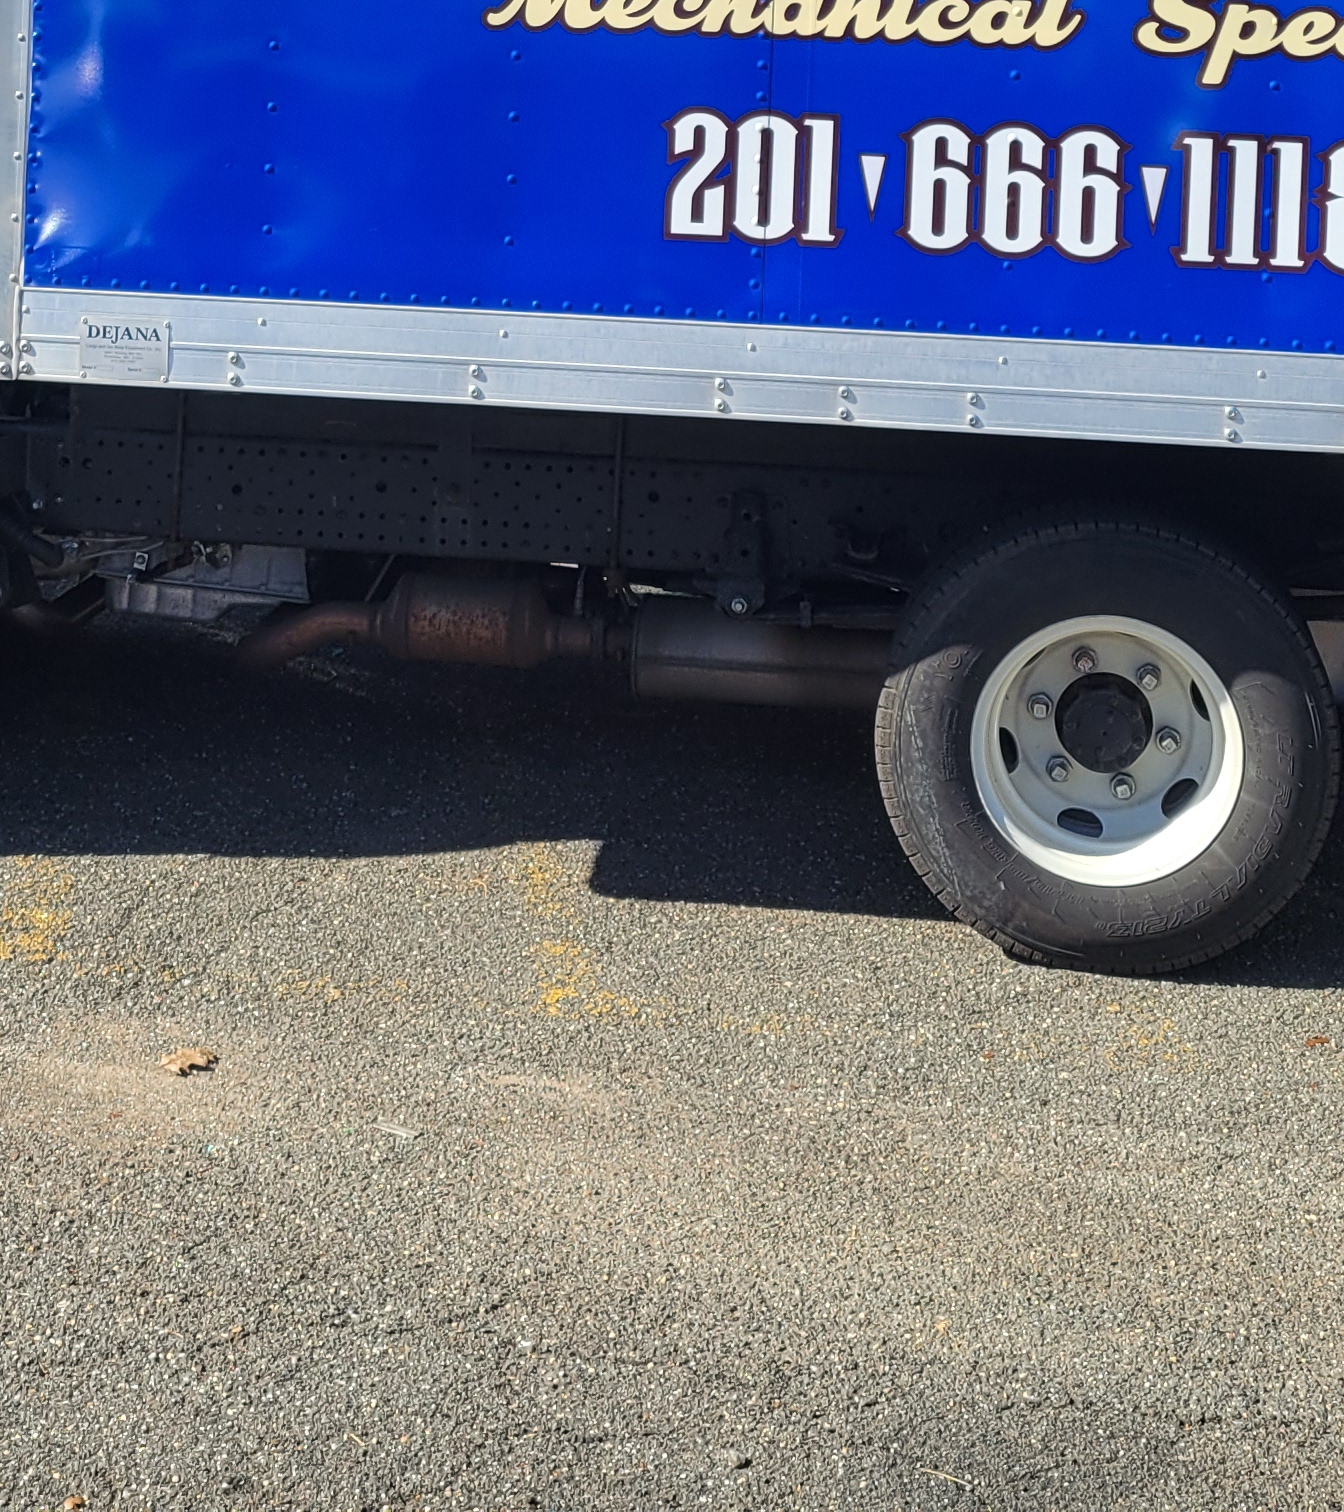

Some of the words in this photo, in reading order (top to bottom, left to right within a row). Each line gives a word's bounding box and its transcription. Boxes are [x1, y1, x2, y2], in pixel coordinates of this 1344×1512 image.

[664, 106, 844, 249] 201
[896, 118, 1133, 264] 666
[86, 324, 162, 344] DEJANA
